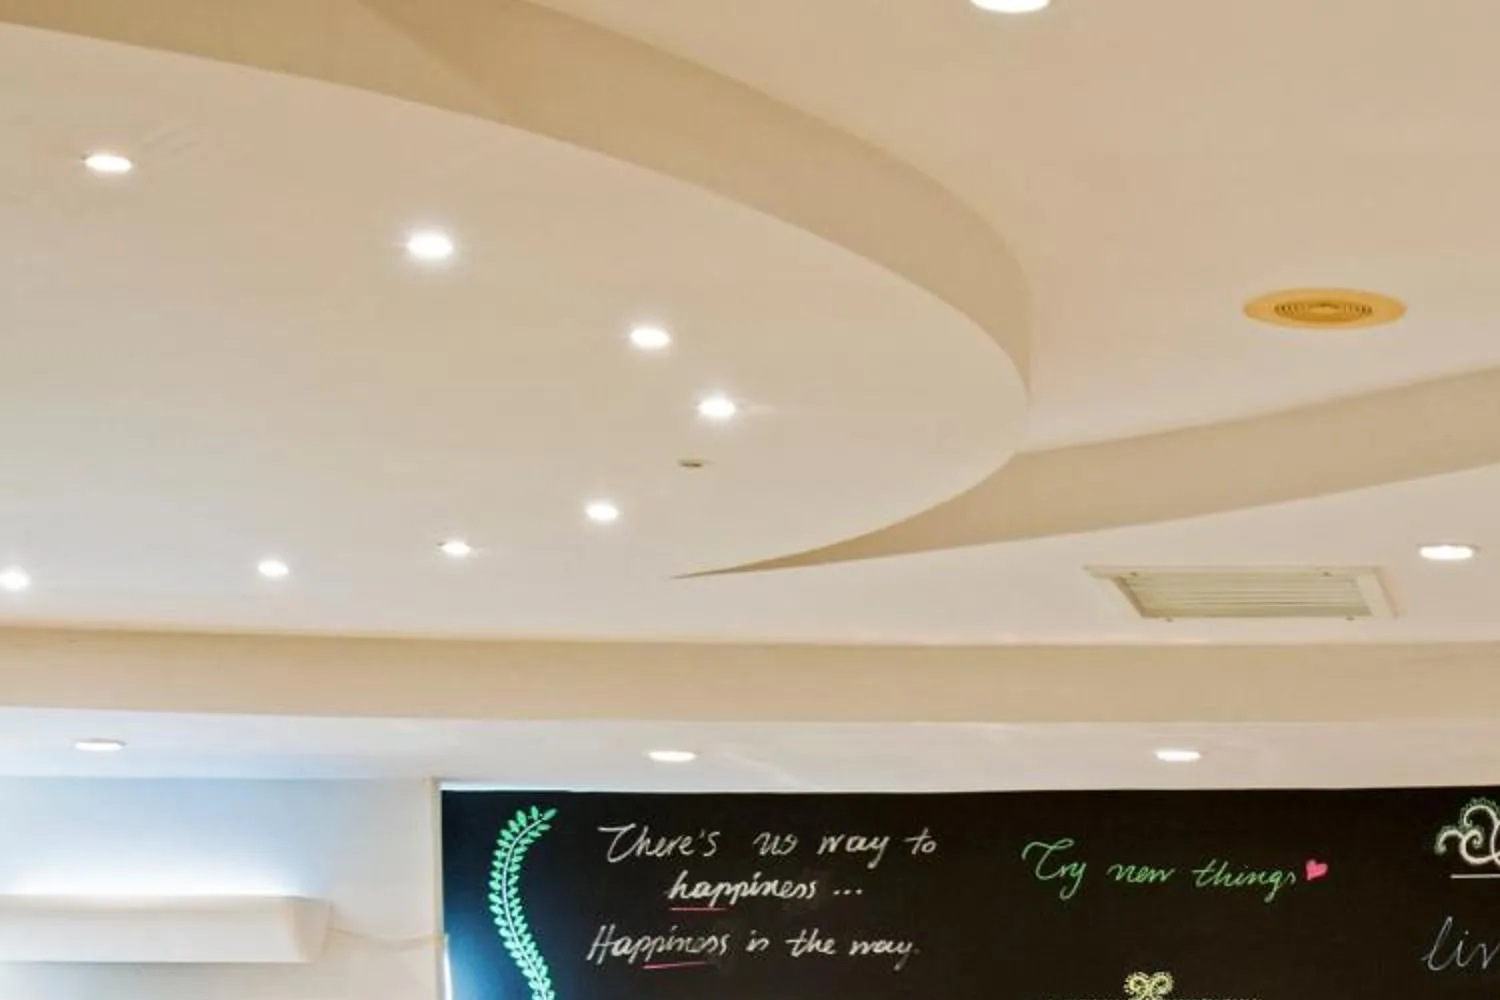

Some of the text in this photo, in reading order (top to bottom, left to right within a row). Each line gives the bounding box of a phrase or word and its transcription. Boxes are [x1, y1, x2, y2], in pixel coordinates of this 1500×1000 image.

[600, 825, 718, 861] There's
[818, 836, 890, 867] way
[905, 829, 936, 854] to
[666, 871, 816, 907] happiness
[1023, 840, 1296, 901] Try new things
[588, 925, 727, 964] Happiness
[747, 931, 768, 951] is
[787, 930, 836, 955] the
